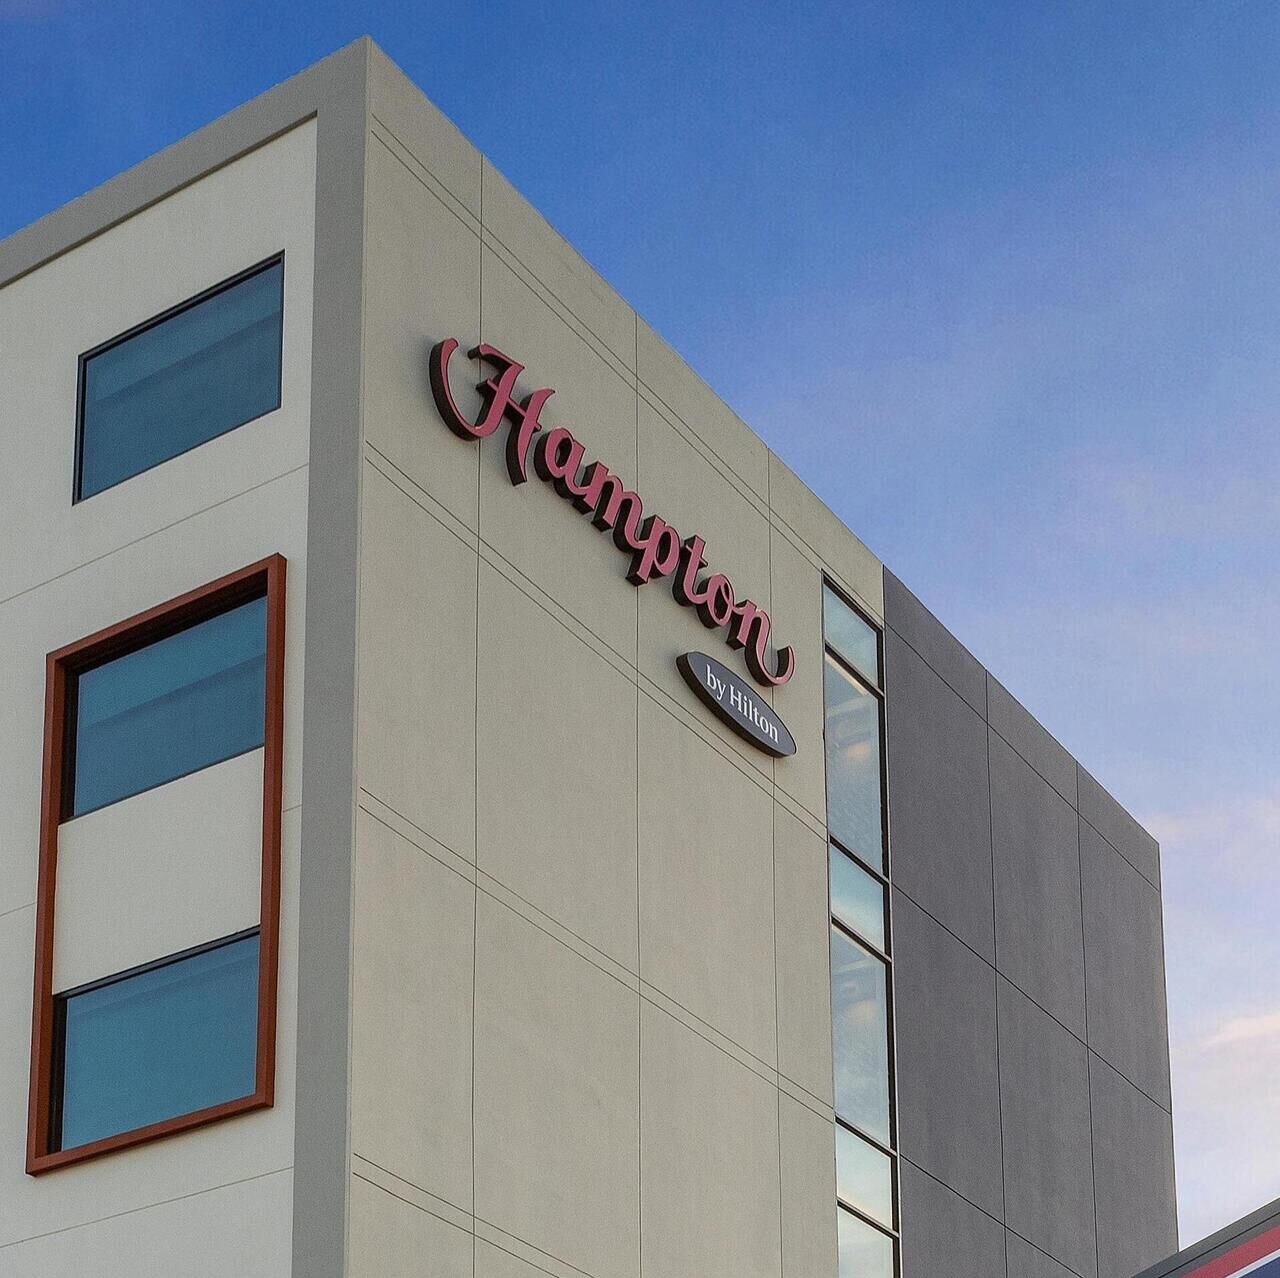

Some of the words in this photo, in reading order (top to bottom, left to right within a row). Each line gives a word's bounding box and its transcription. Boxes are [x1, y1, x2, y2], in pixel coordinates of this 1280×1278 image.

[429, 337, 795, 687] Hampton
[706, 663, 726, 701] by
[729, 684, 779, 744] Hilton
